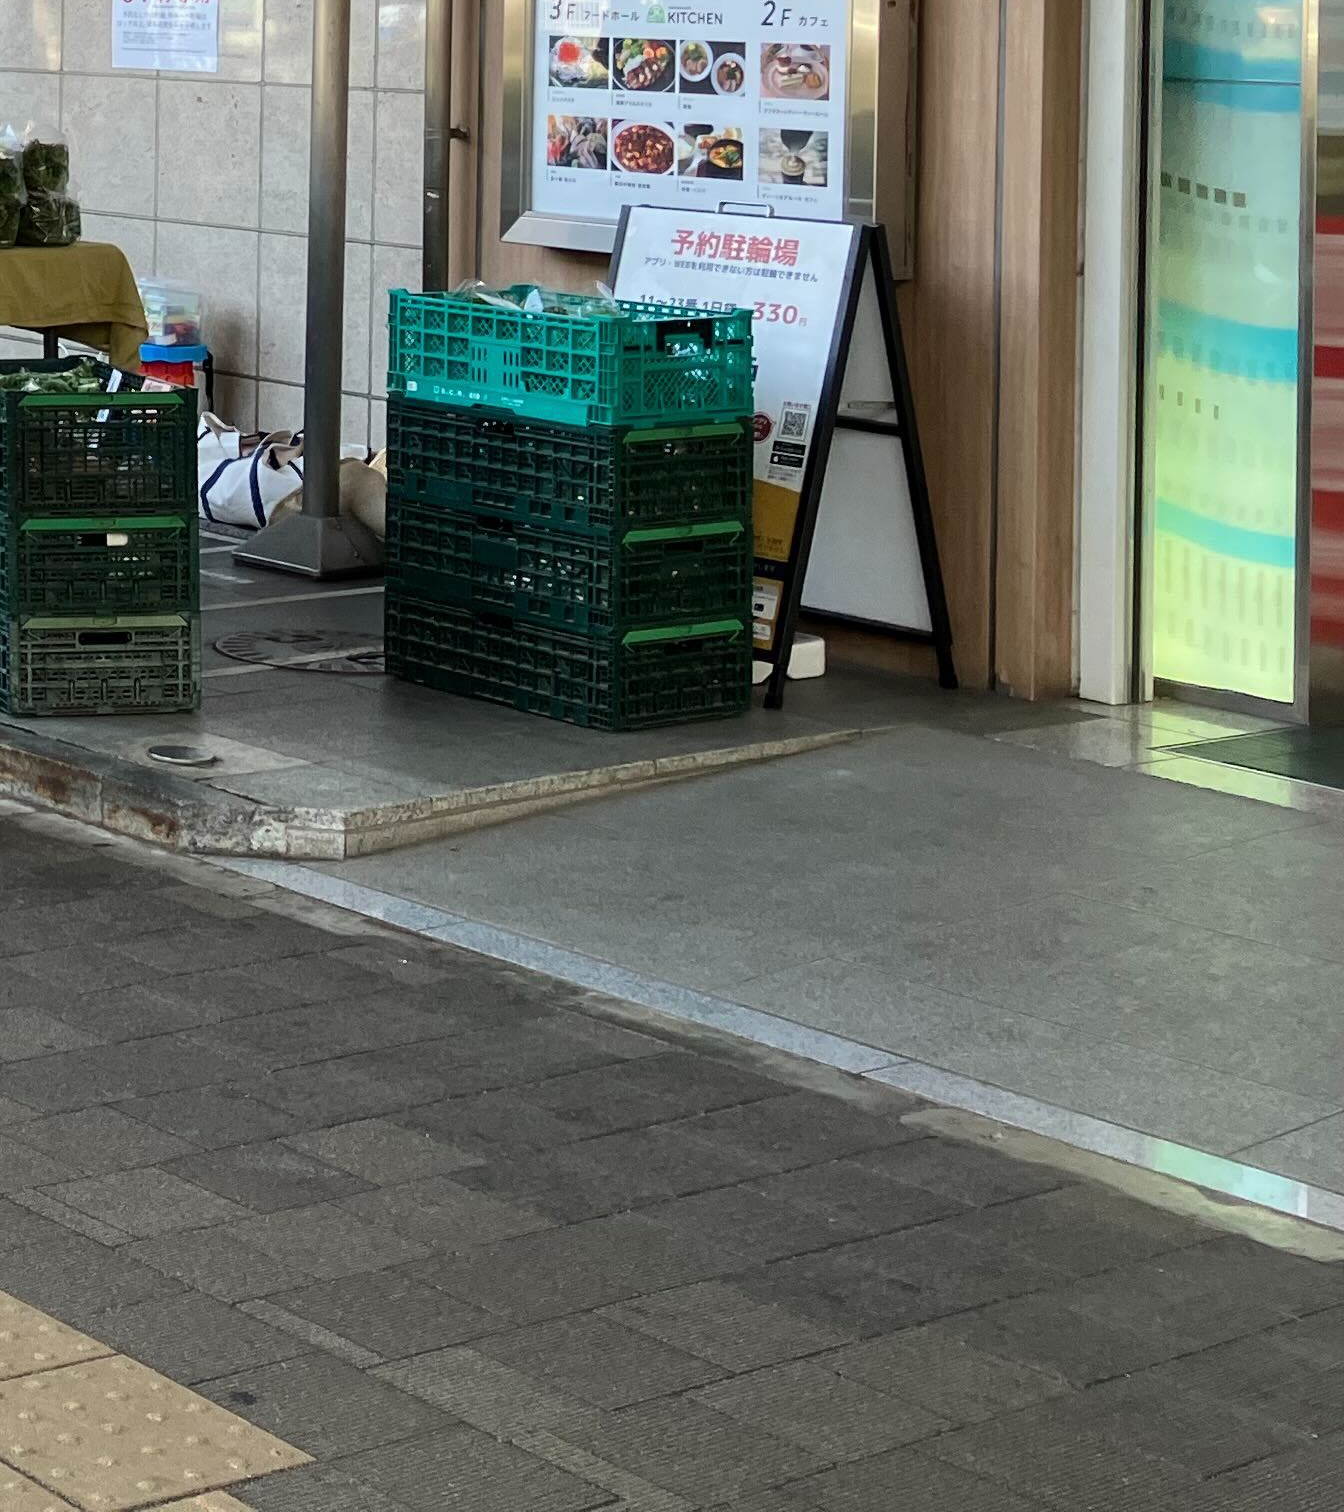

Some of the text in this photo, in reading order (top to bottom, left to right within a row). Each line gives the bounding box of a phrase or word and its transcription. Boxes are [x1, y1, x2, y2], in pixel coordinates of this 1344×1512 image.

[584, 7, 640, 22] フードホール
[668, 11, 724, 25] KITCHEN
[761, 0, 829, 28] 2F カフェ
[670, 229, 801, 267] 予約駐輪場
